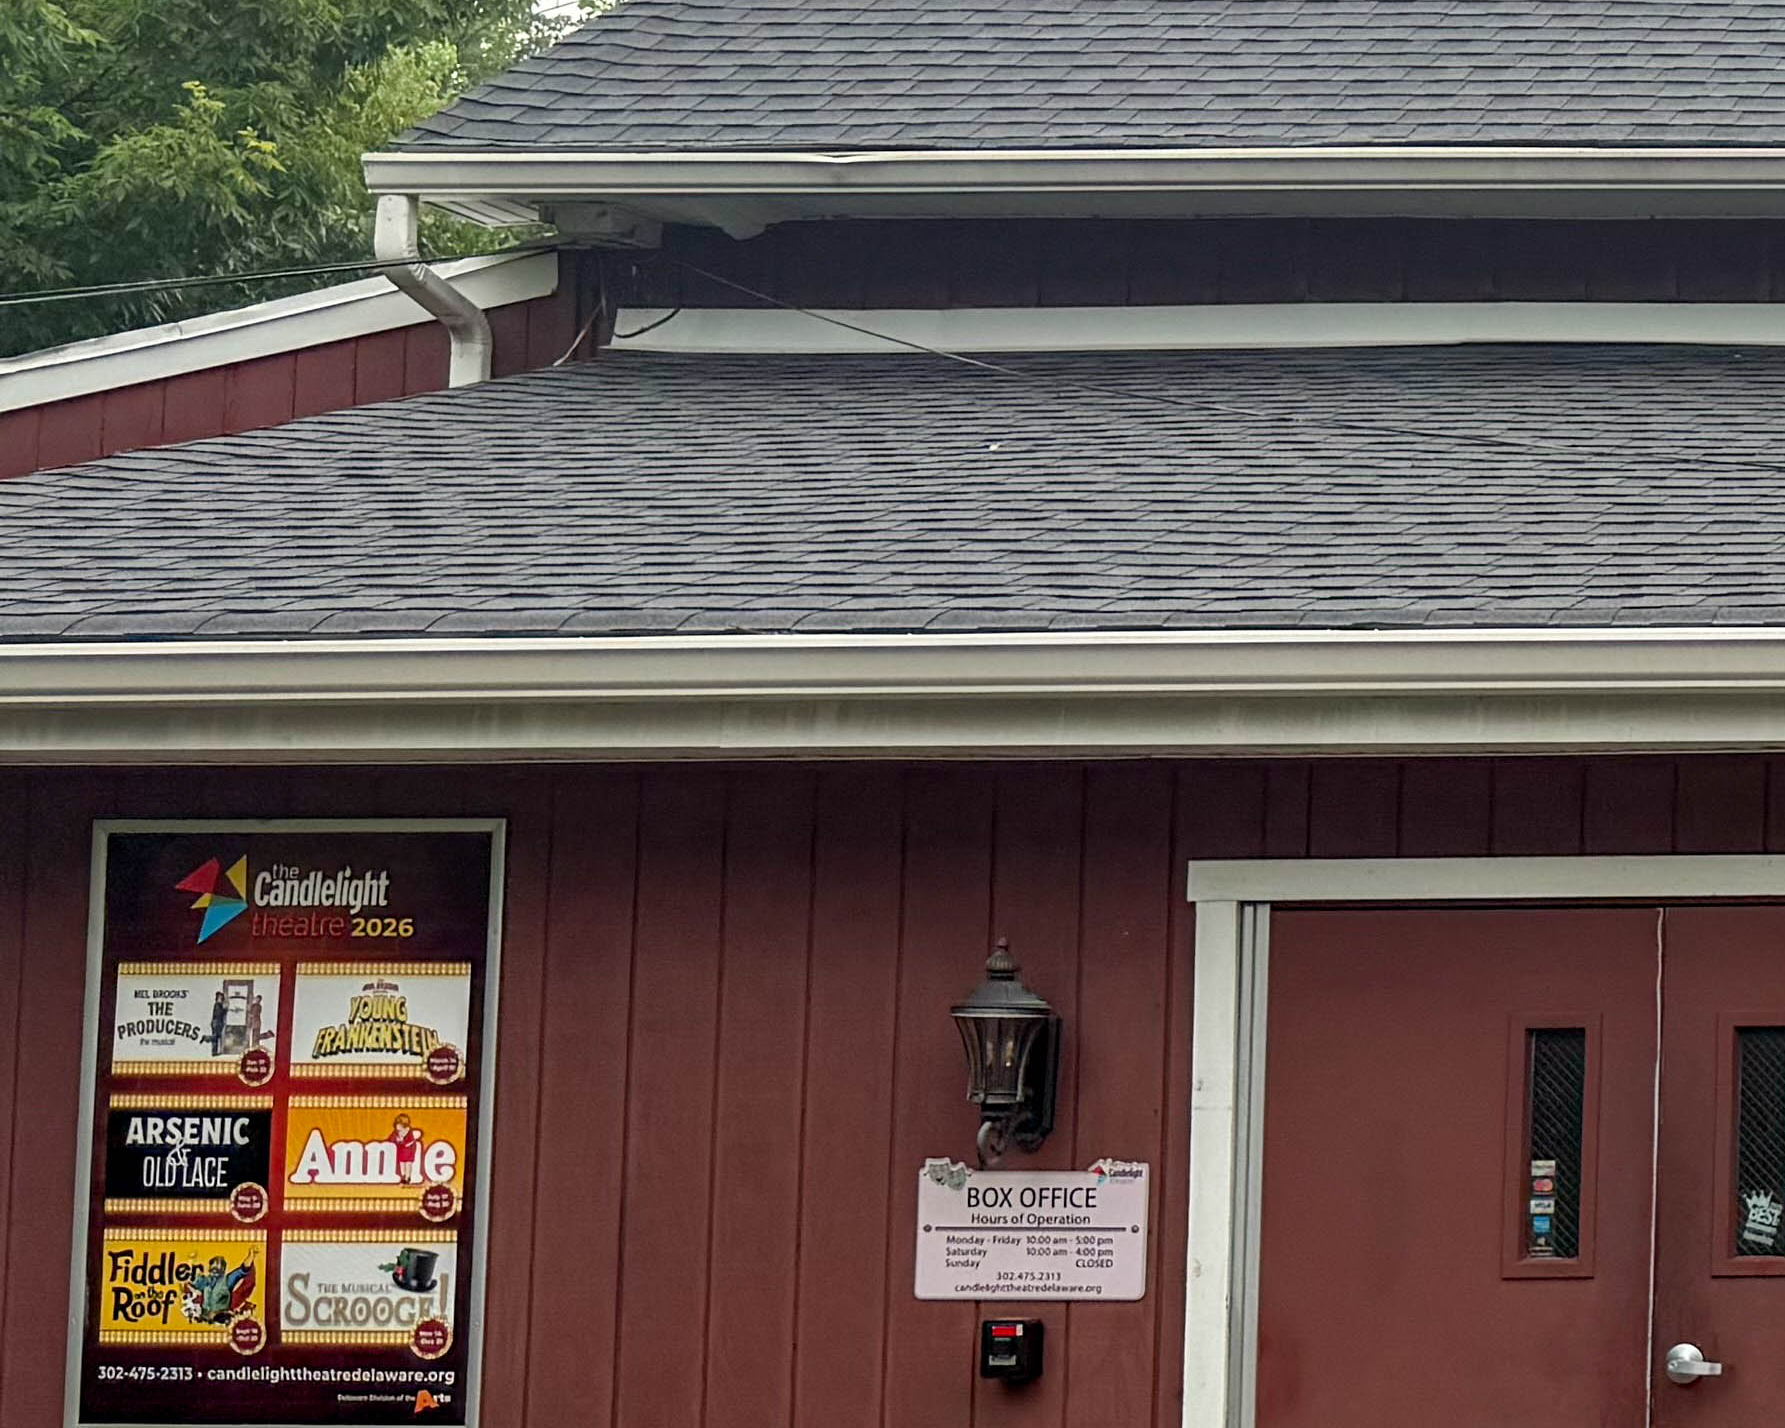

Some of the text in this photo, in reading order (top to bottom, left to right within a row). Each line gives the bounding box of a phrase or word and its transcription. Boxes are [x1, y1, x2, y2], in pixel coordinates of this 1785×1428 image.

[272, 863, 300, 880] the
[254, 868, 390, 915] Candlelight
[251, 912, 414, 937] theatre 2026
[147, 1001, 174, 1016] THE
[349, 995, 408, 1023] YOUNG
[117, 1019, 201, 1041] PRODUCERS
[312, 1022, 440, 1059] FRANKENSTEIN
[126, 1117, 250, 1145] ARSENIC
[167, 1137, 191, 1166] &
[289, 1128, 456, 1184] Annie
[143, 1156, 229, 1187] OLD LACE
[967, 1187, 1097, 1208] BOX OFFICE
[971, 1213, 1091, 1227] Hours of Operation
[946, 1236, 985, 1246] Monday
[993, 1236, 1021, 1247] Friday
[1053, 1237, 1067, 1245] am
[1097, 1237, 1113, 1247] pm
[946, 1248, 987, 1258] Saturday
[1052, 1249, 1067, 1257] am
[1097, 1249, 1113, 1258] pm
[108, 1249, 204, 1286] Fiddler
[946, 1259, 1113, 1270] Sunday CLOSED
[318, 1283, 338, 1293] THE
[112, 1287, 177, 1324] Roof
[207, 1367, 455, 1385] candlelighttheatredelaware.org
